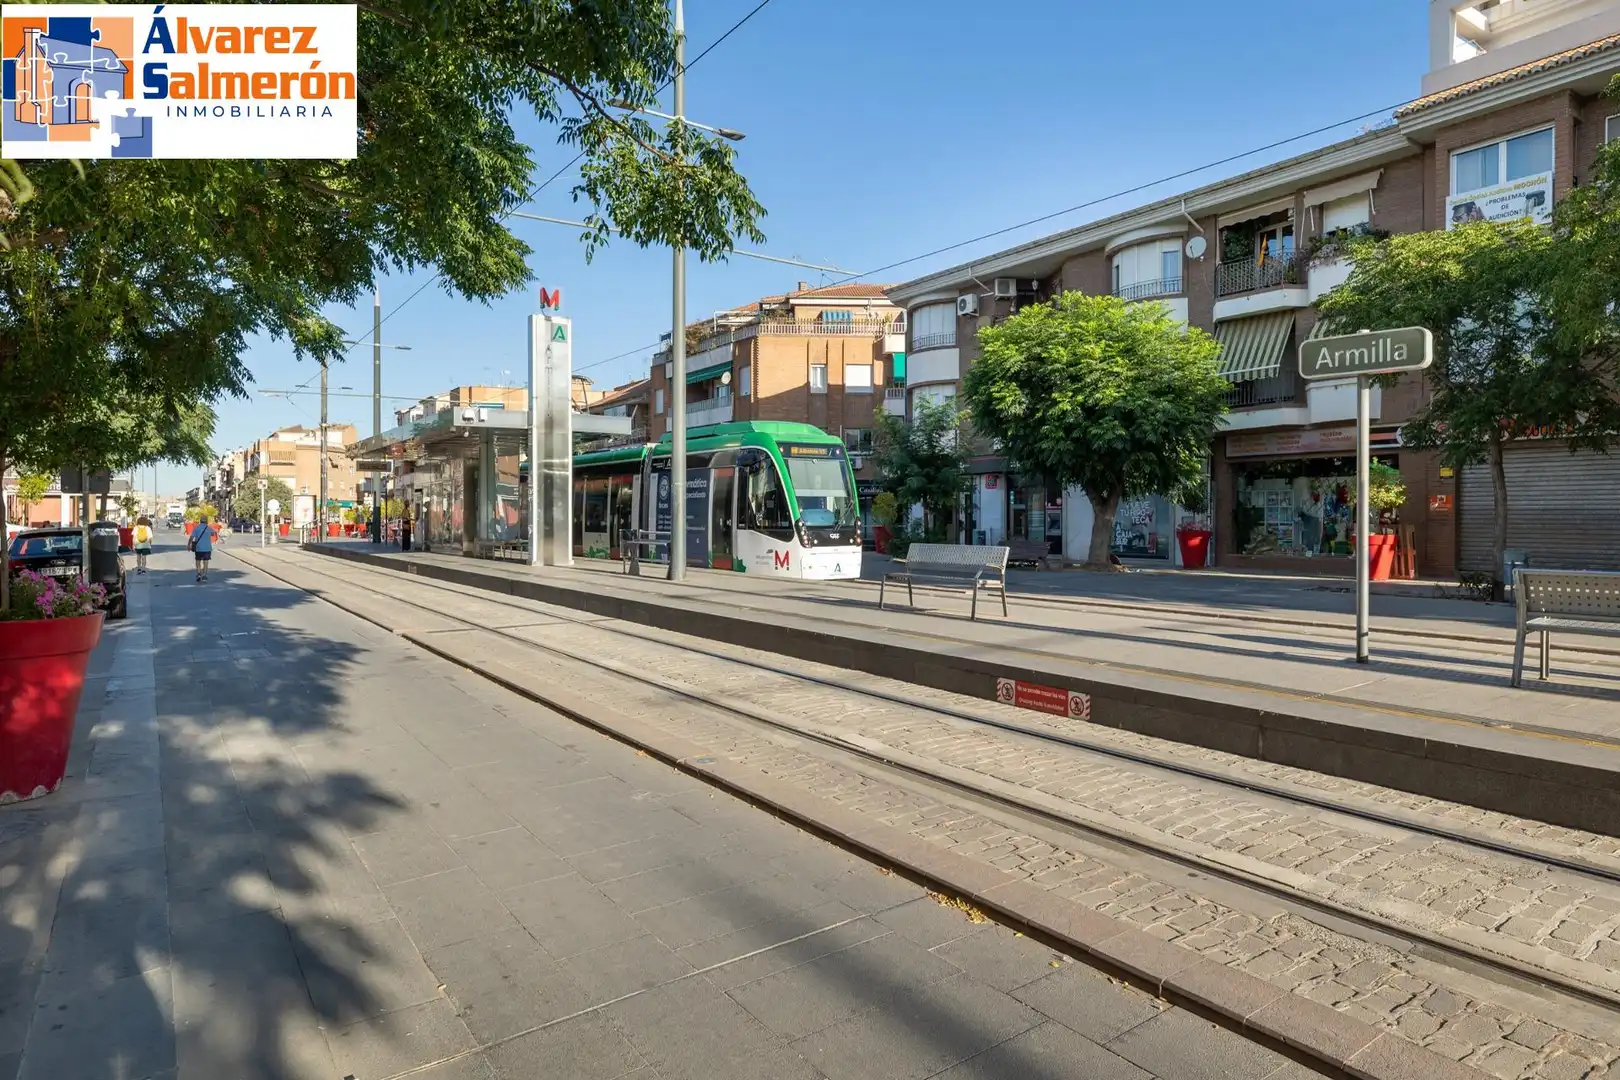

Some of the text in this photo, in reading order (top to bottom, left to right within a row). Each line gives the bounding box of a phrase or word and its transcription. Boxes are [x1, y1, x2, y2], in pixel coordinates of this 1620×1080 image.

[1485, 191, 1527, 207] ¿PROBLEMAS
[1500, 203, 1510, 211] DE
[539, 286, 560, 311] M
[1315, 337, 1408, 370] Armilla
[774, 550, 791, 571] M
